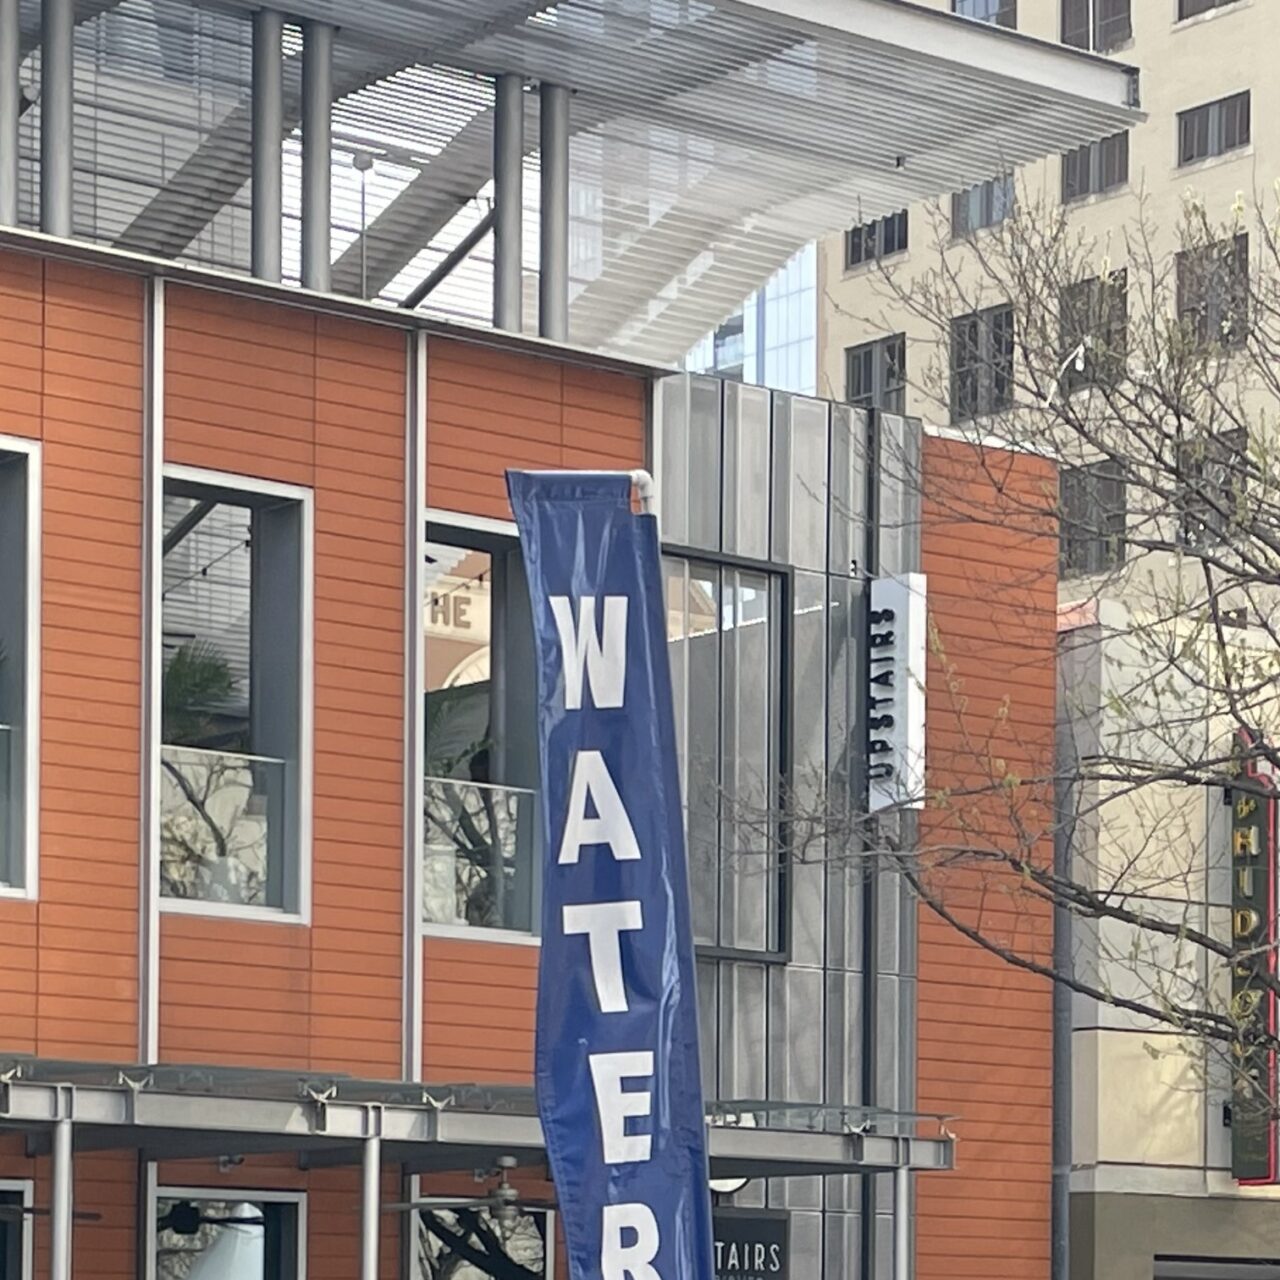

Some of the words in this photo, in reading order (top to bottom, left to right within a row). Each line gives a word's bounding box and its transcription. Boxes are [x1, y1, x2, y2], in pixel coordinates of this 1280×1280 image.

[424, 592, 471, 629] HE
[868, 609, 895, 780] UPSTAIRS
[715, 1242, 780, 1272] TAIRS
